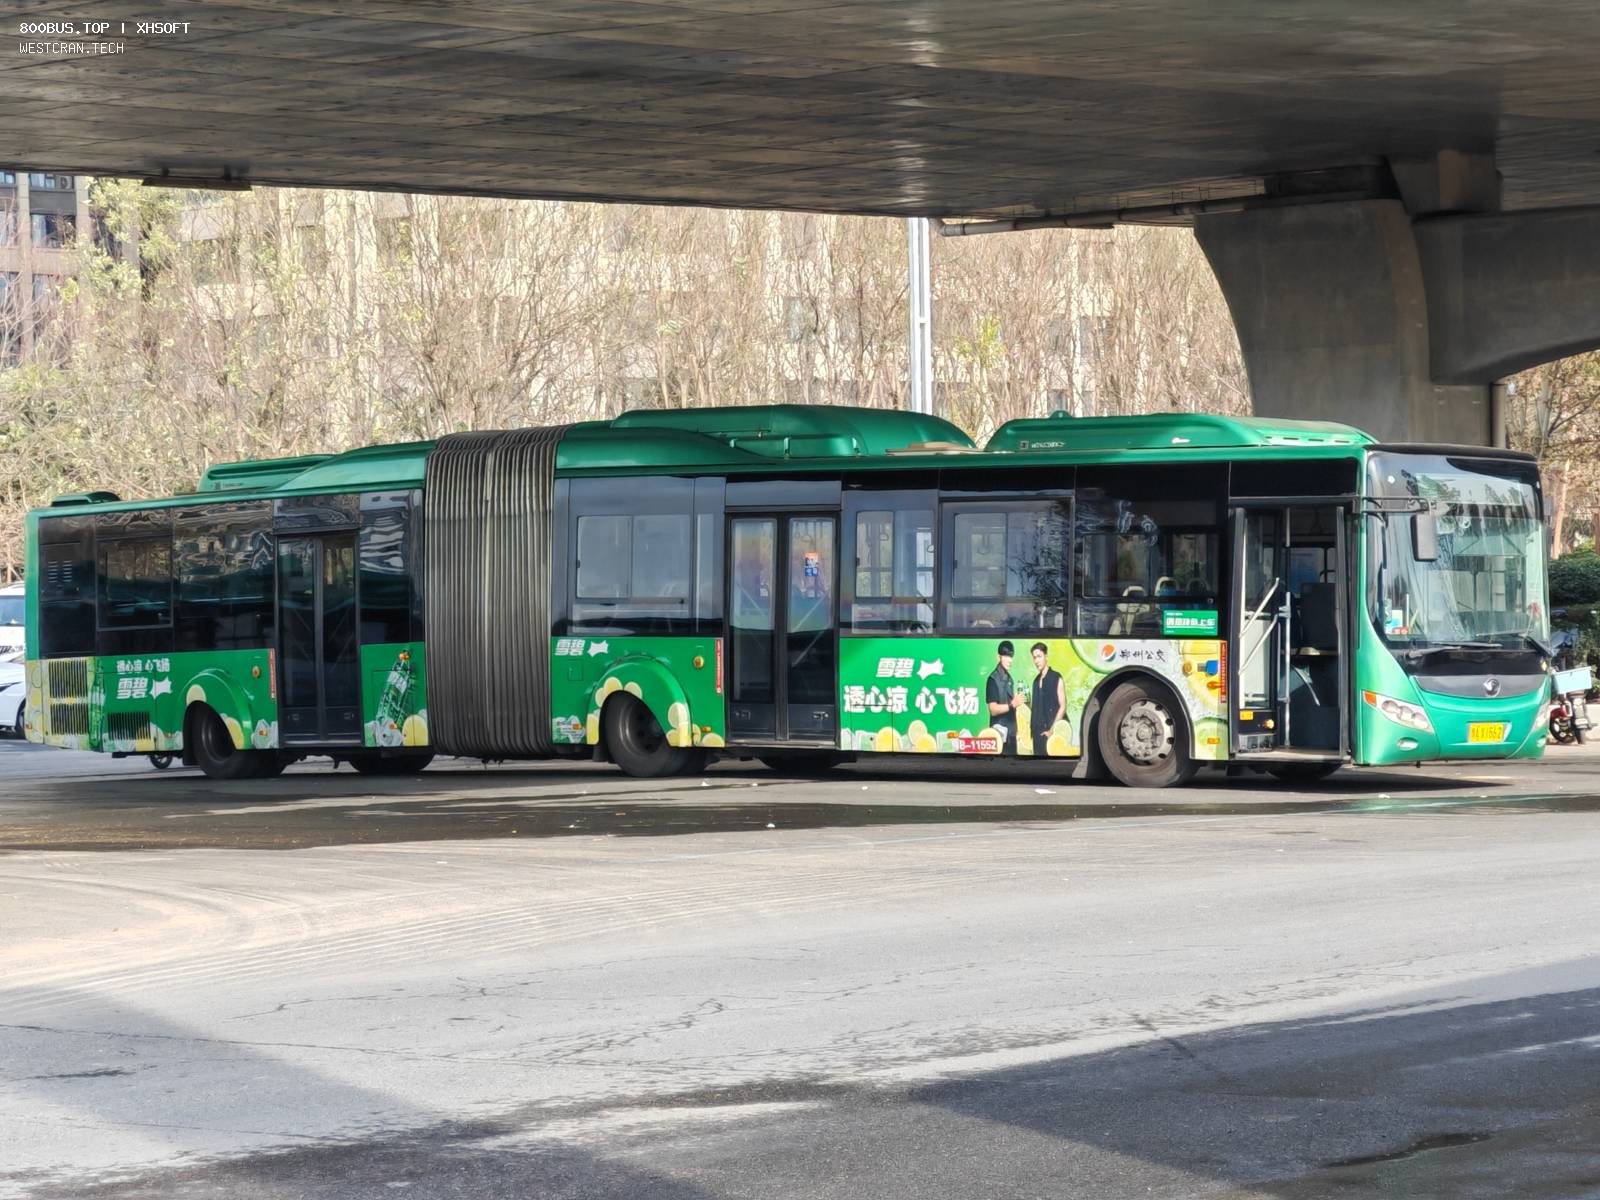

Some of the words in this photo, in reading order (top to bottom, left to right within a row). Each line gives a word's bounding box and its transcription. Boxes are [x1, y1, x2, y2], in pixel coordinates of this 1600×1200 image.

[554, 638, 586, 656] 雪碧
[875, 657, 915, 678] 雪碧
[116, 677, 149, 699] 雪碧
[843, 685, 909, 714] 透心凉
[915, 686, 979, 715] 心飞扬
[959, 739, 997, 751] B-11552
